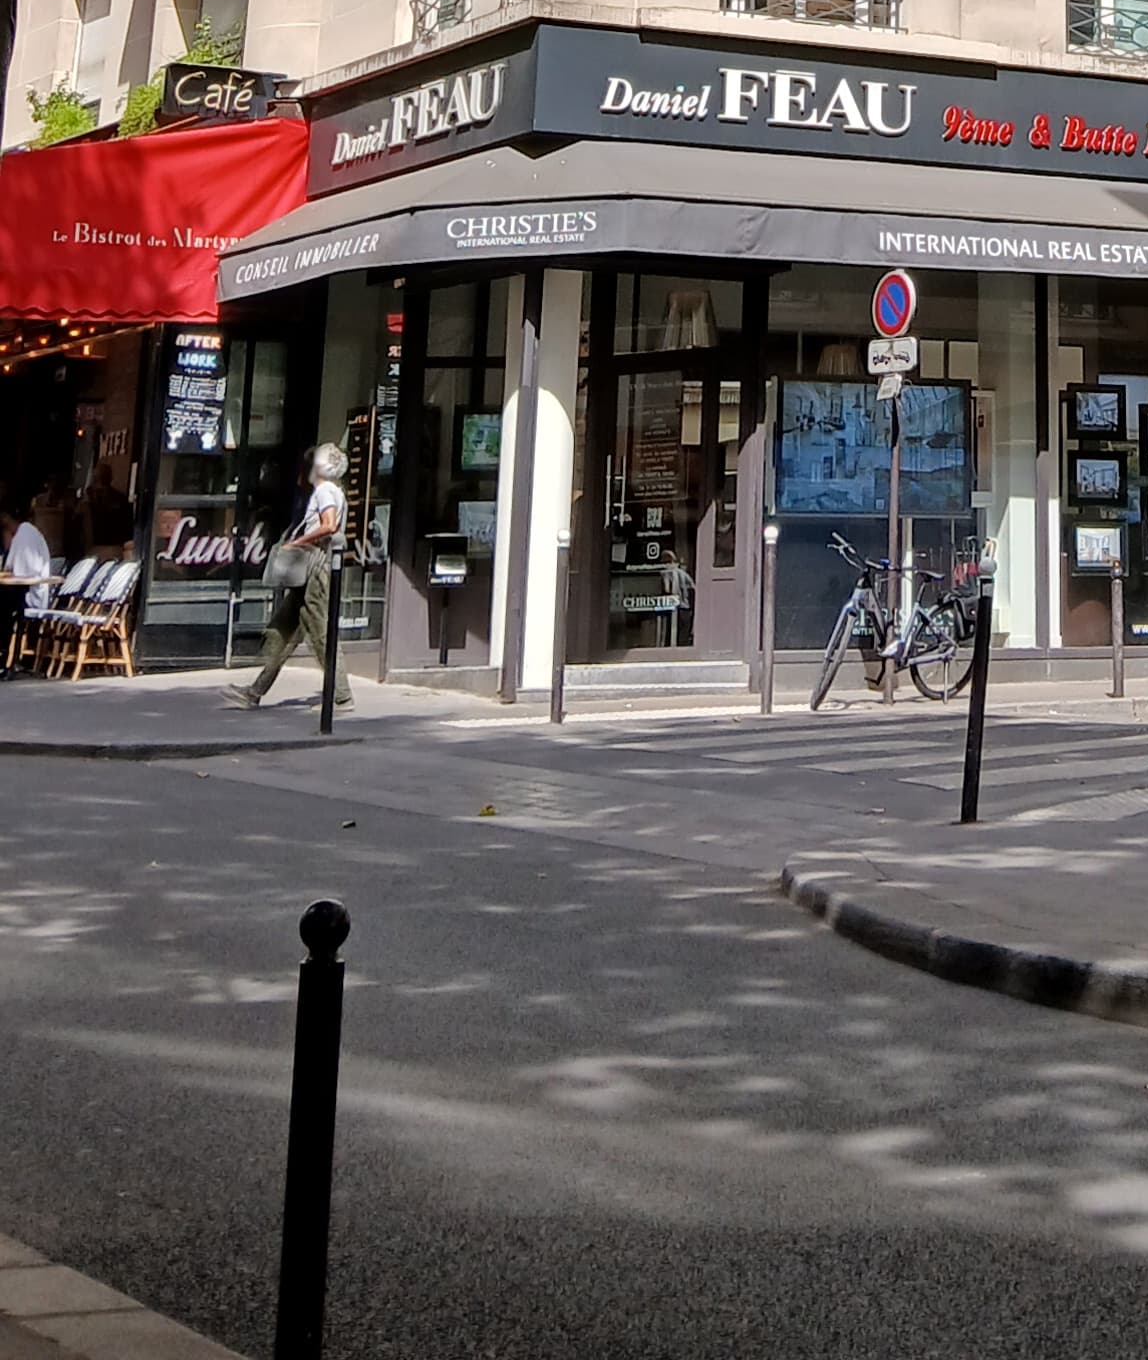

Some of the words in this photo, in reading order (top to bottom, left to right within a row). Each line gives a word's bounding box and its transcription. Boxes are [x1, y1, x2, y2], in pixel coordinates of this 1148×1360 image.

[174, 70, 256, 114] Café
[600, 76, 712, 120] Daniel
[331, 118, 389, 166] Daniel
[942, 104, 1015, 146] 9ème
[1027, 112, 1051, 148] &
[1059, 113, 1138, 156] Butte
[52, 230, 68, 243] Le
[73, 222, 141, 246] Bistrot
[147, 235, 167, 248] des
[173, 227, 244, 251] Martyr
[447, 210, 598, 239] CHRISTIE'S
[456, 234, 528, 249] INTERNATIONAL
[529, 233, 552, 245] REAL
[553, 232, 585, 244] ESTATE
[878, 231, 1044, 260] INTERNATIONAL
[1048, 240, 1097, 262] REAL
[235, 255, 290, 285] CONSEIL
[294, 232, 380, 271] IMMOBILIER
[175, 333, 222, 349] AFTER
[177, 351, 217, 368] WORK
